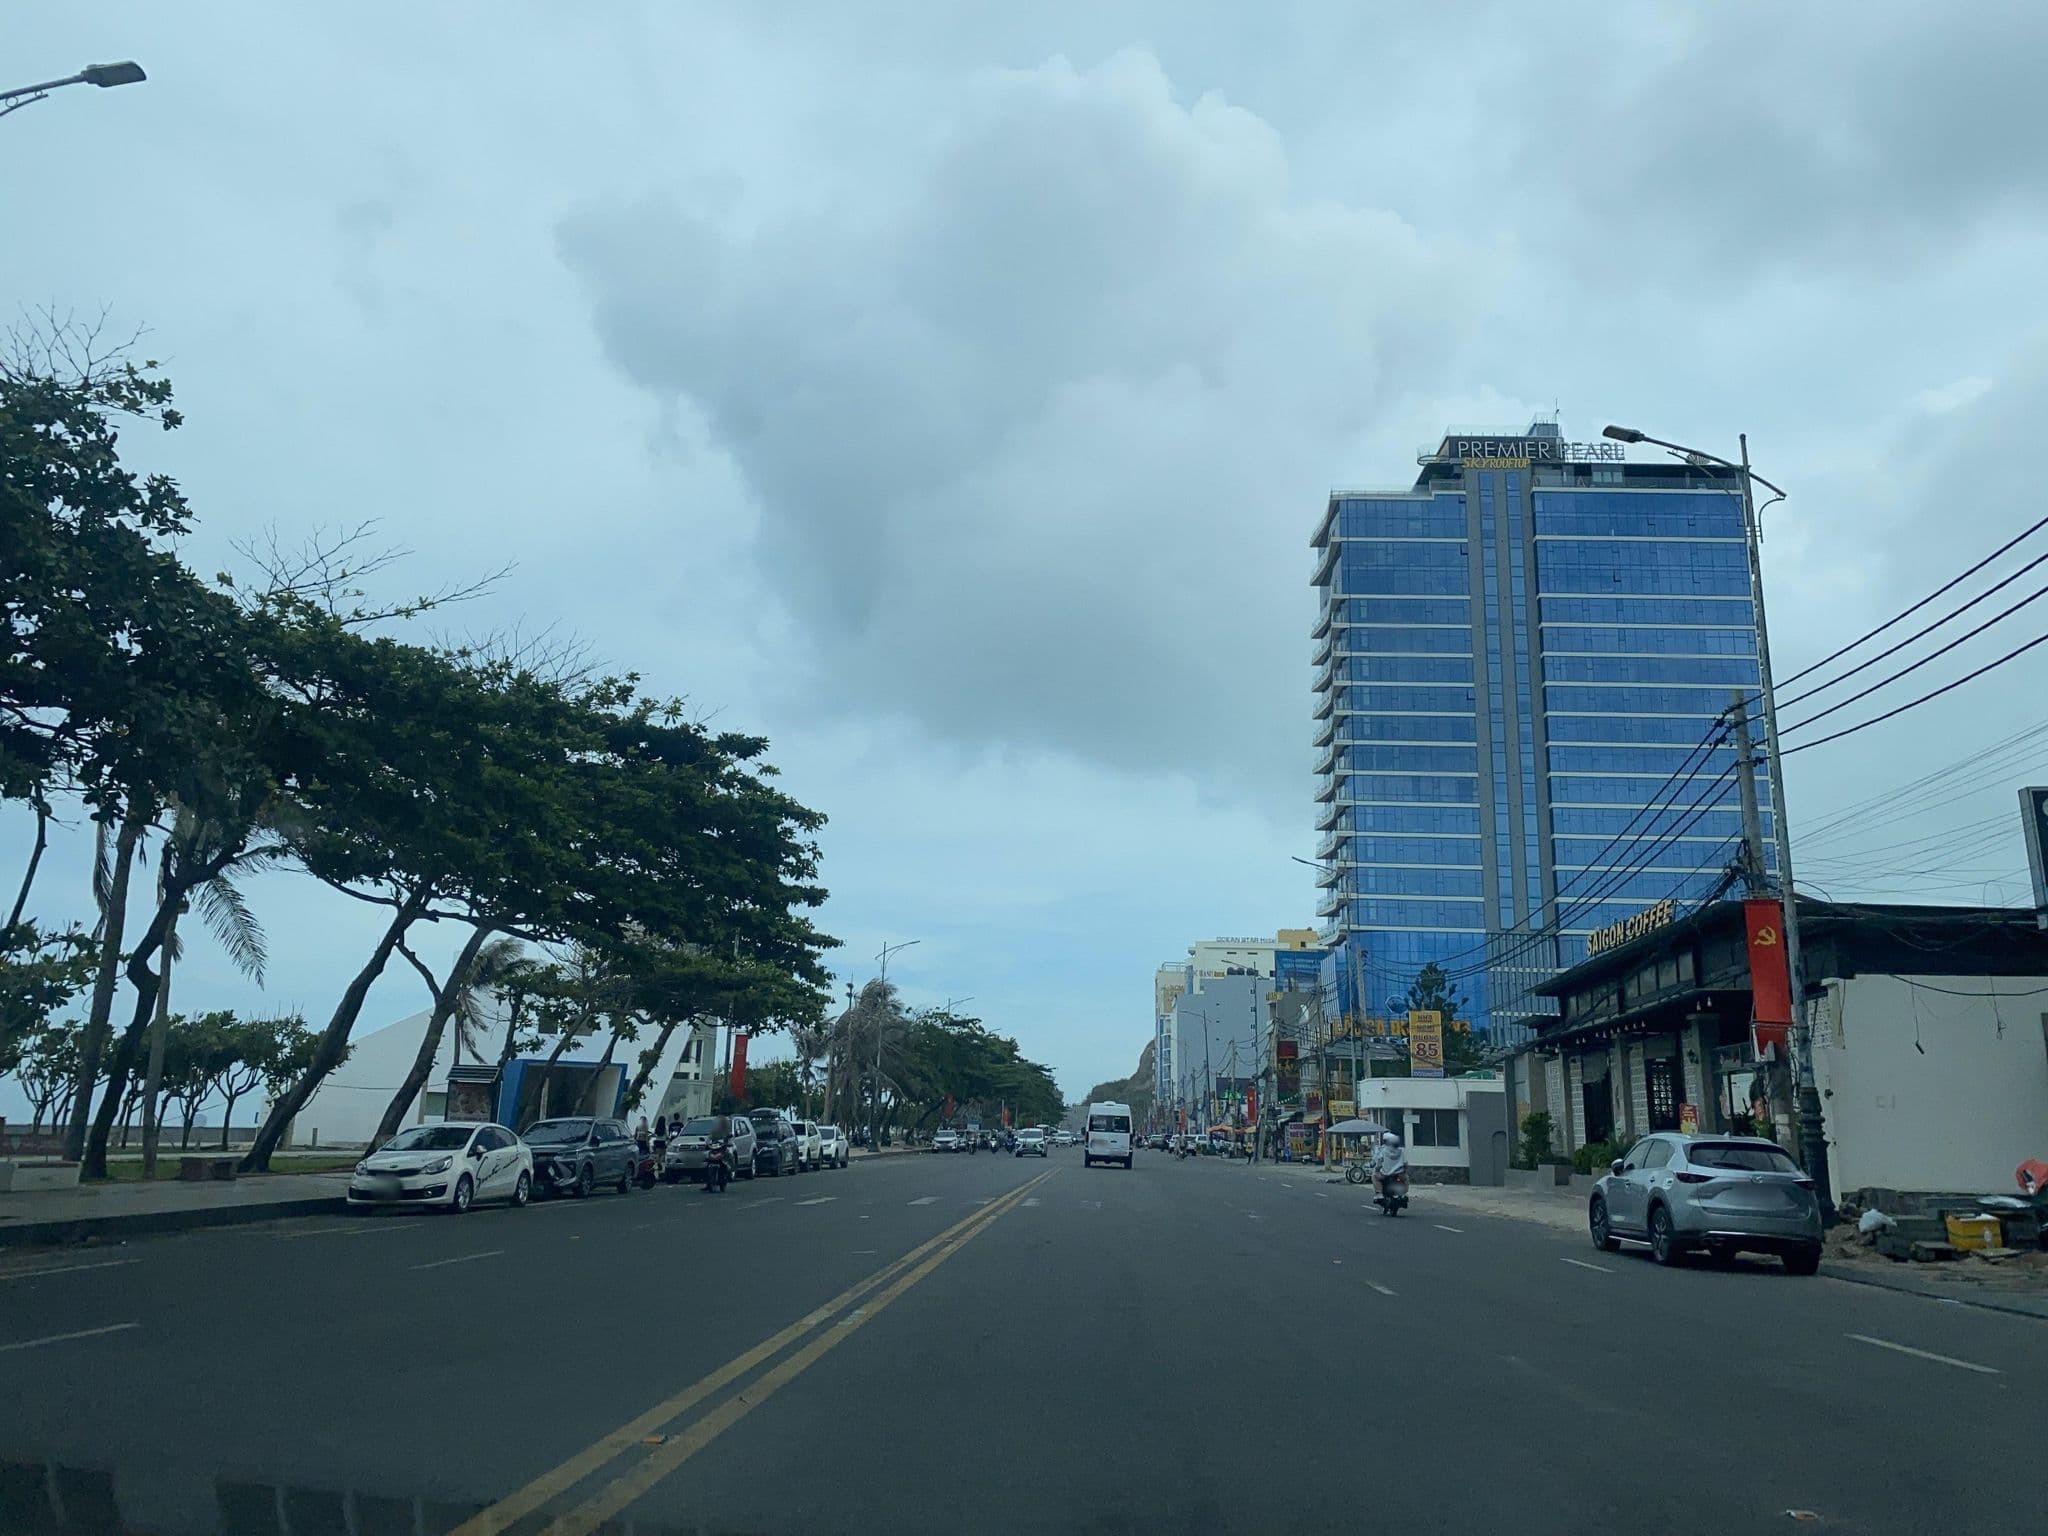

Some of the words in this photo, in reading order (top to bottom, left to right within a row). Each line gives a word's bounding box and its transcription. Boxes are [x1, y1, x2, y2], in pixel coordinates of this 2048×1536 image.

[1457, 440, 1550, 460] PREMIER
[1559, 442, 1625, 461] PEARL
[1625, 899, 1675, 940] COFFEE
[1415, 1041, 1439, 1057] 85
